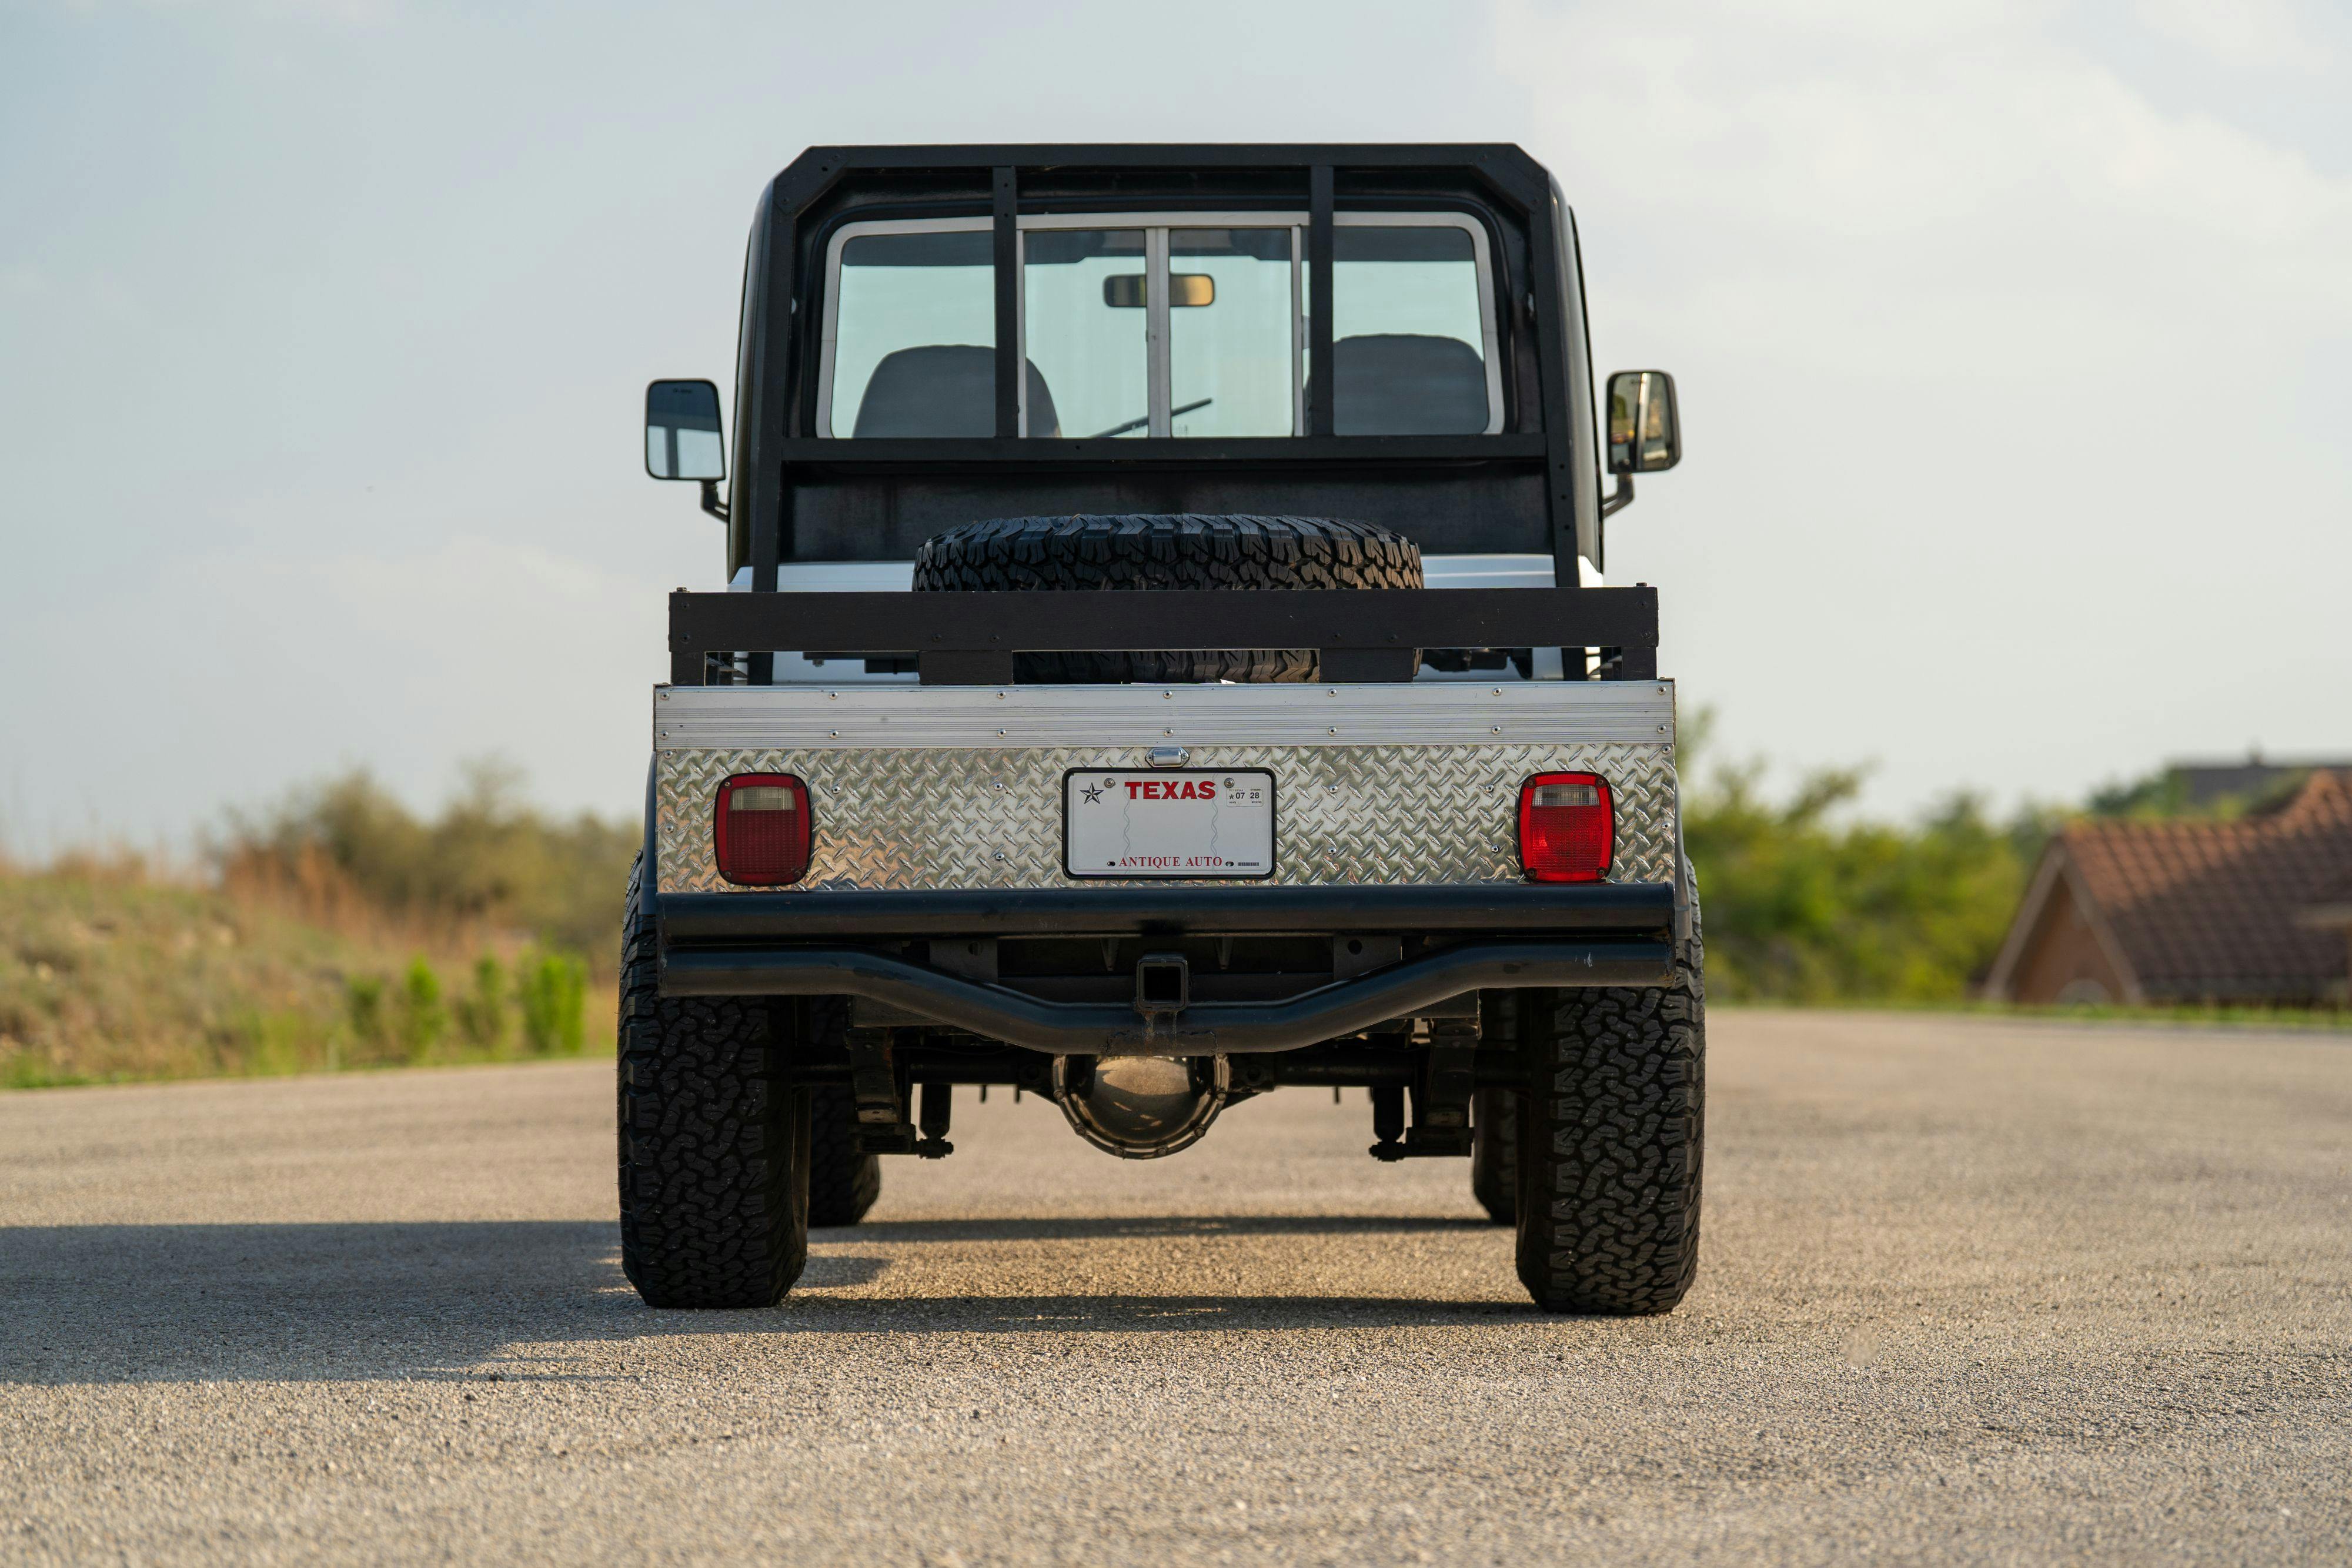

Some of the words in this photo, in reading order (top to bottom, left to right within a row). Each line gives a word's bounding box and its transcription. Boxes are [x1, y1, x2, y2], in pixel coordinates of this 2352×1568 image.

[1124, 781, 1215, 799] TEXAS
[1118, 857, 1180, 868] ANTIQUE
[1185, 857, 1222, 867] AUTO
